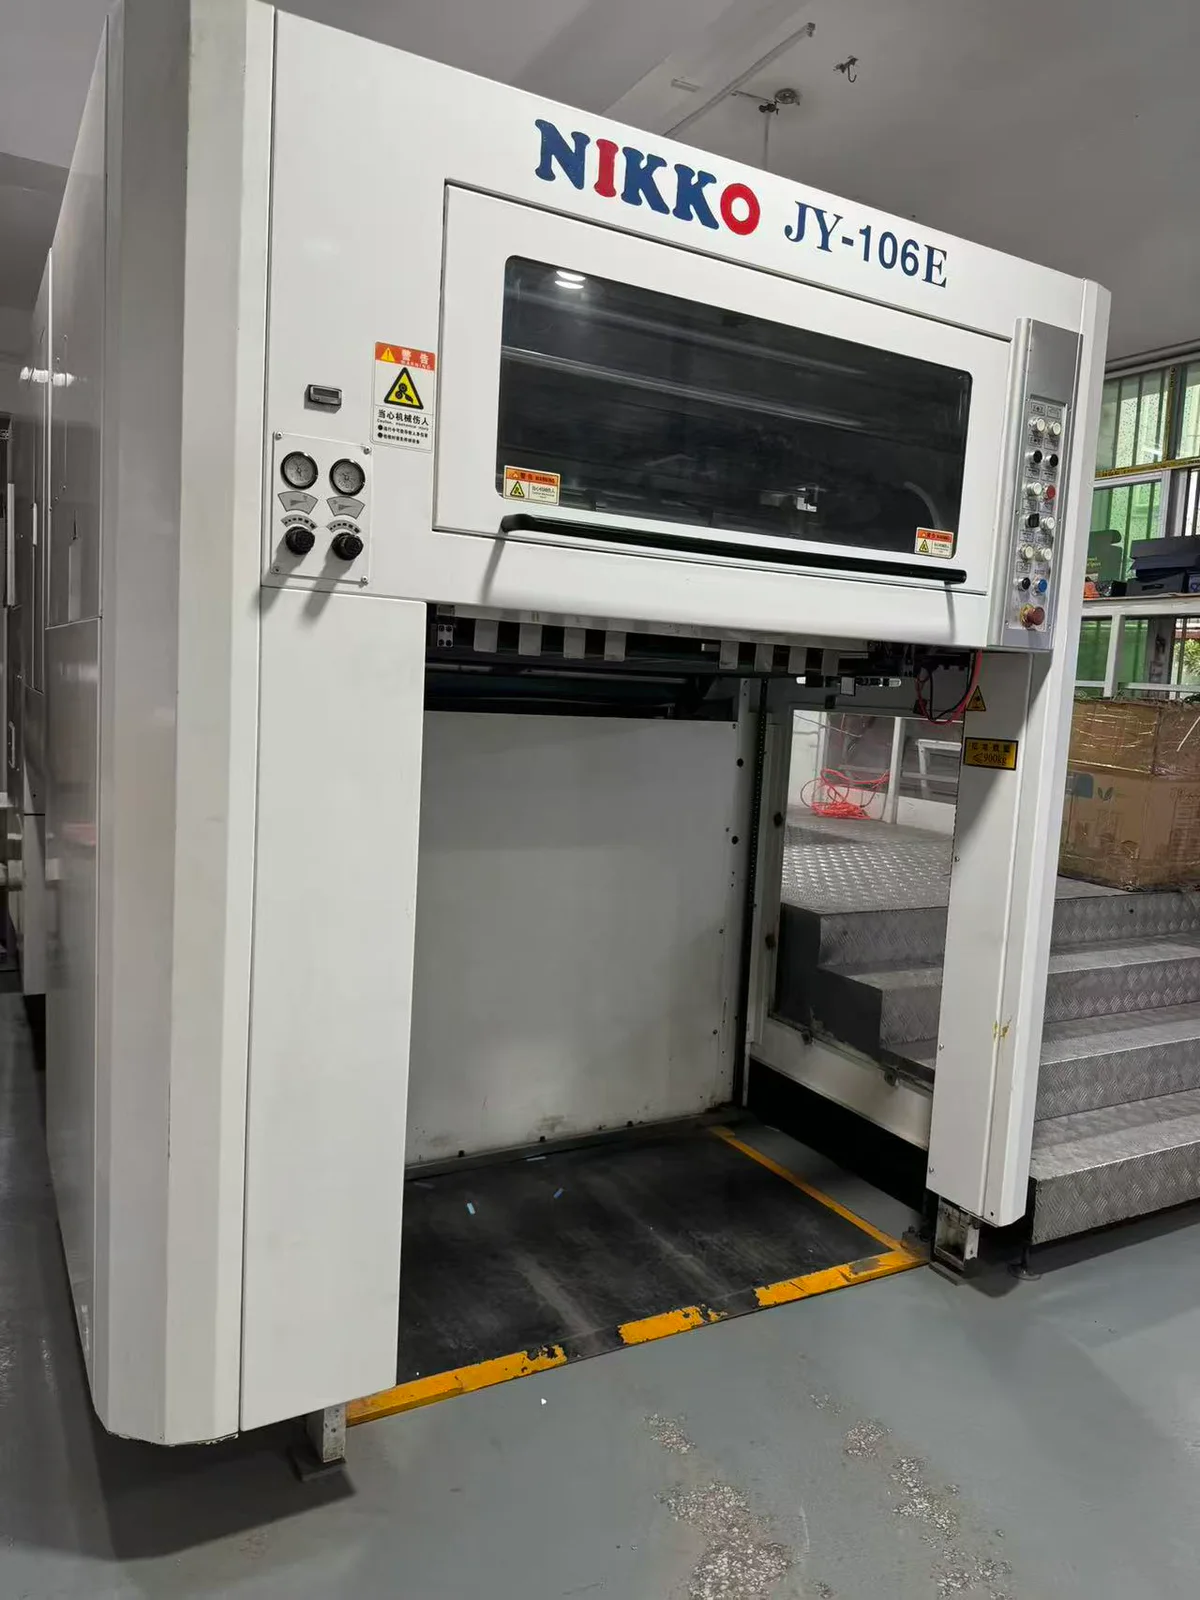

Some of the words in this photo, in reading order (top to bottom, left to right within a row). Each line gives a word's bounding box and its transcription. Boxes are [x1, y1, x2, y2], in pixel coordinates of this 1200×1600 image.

[535, 119, 760, 236] NIKKO
[784, 201, 948, 288] JY-106E
[401, 349, 429, 365] 警告
[378, 409, 429, 426] 当心机械伤人
